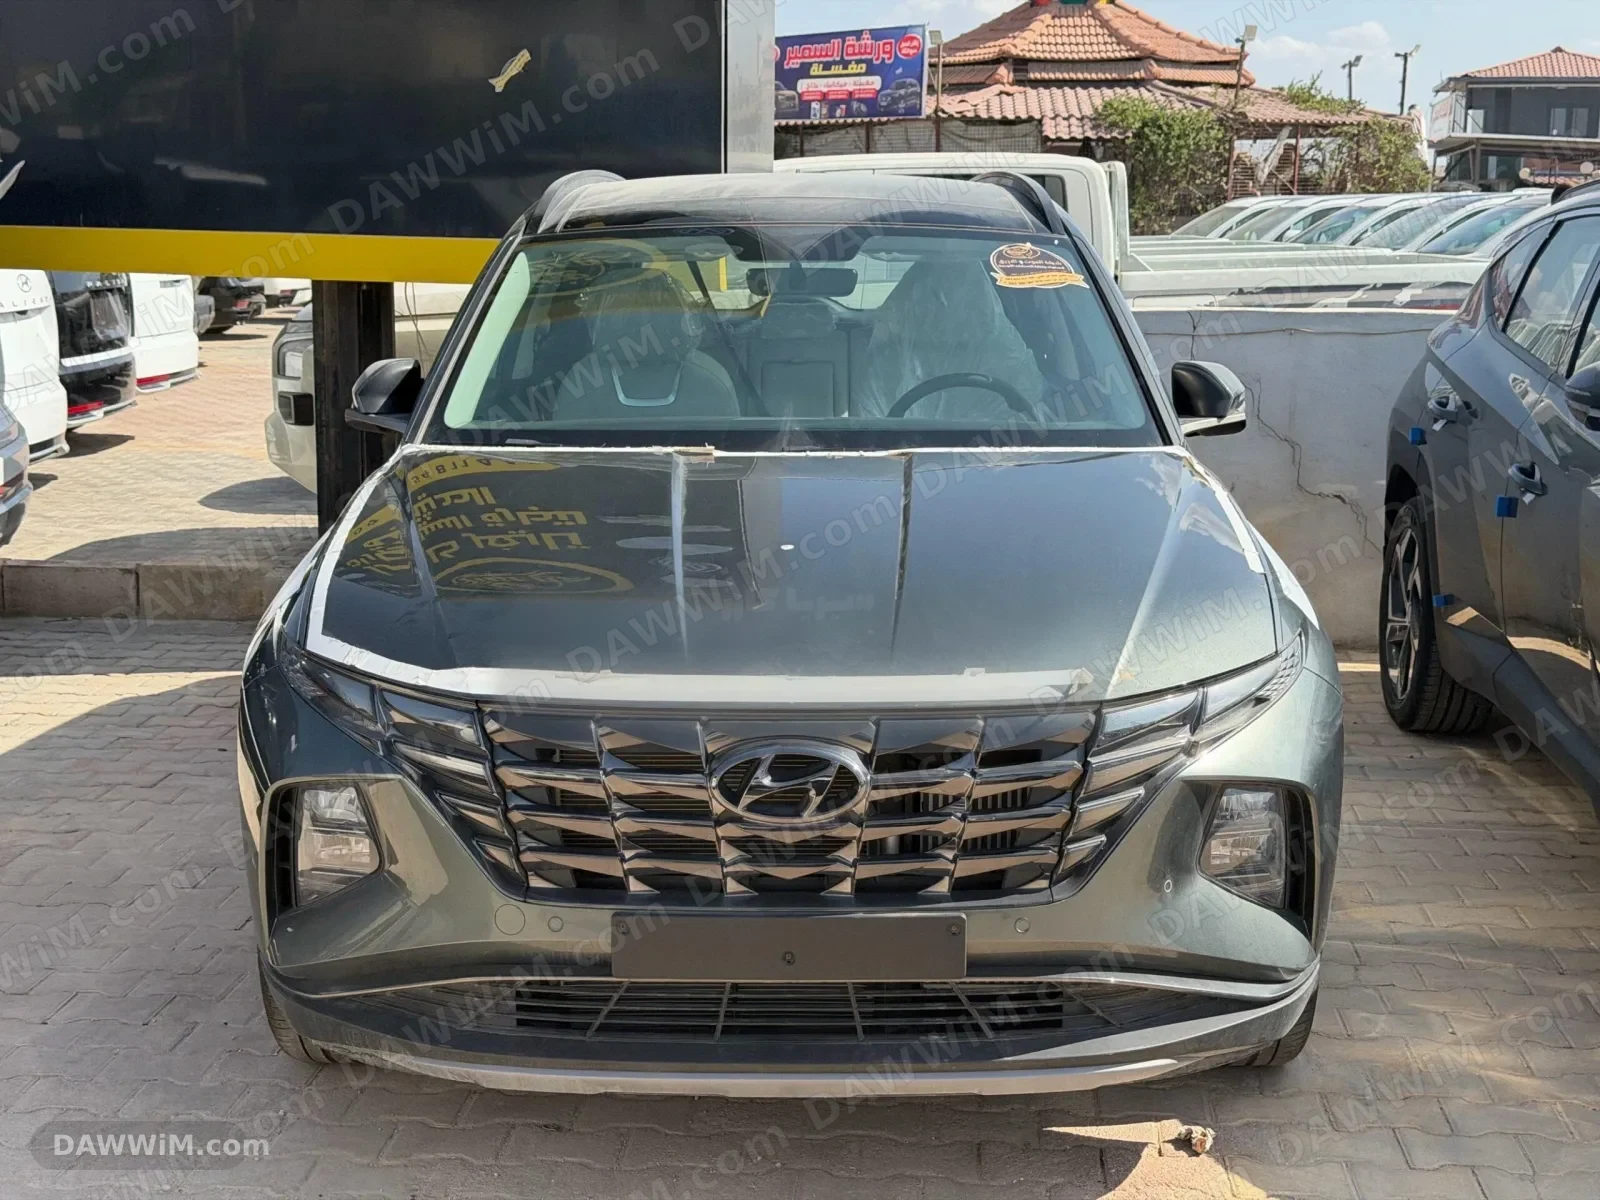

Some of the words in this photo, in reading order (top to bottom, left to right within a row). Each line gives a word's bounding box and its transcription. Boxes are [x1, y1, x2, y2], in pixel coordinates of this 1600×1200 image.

[784, 39, 841, 68] السمير
[844, 30, 895, 64] ورشة
[810, 61, 867, 75] مغسلة
